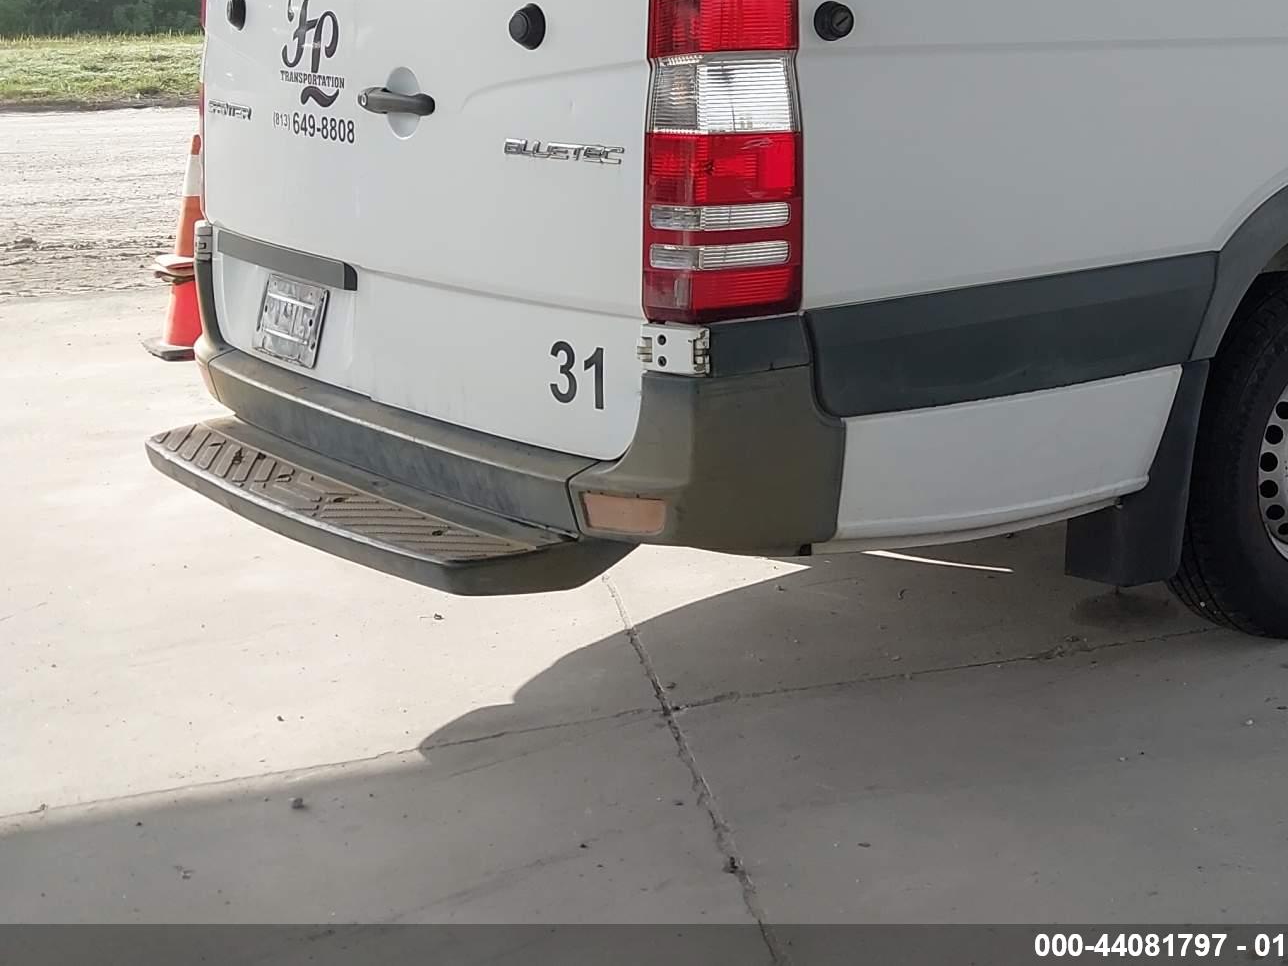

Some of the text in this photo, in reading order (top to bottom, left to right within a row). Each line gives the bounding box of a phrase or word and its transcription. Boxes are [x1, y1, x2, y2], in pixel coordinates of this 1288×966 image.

[279, 70, 345, 89] TRANSPORTATION
[273, 111, 355, 144] (813) 649-8808
[503, 137, 625, 165] BLUETEC
[549, 340, 604, 411] 31
